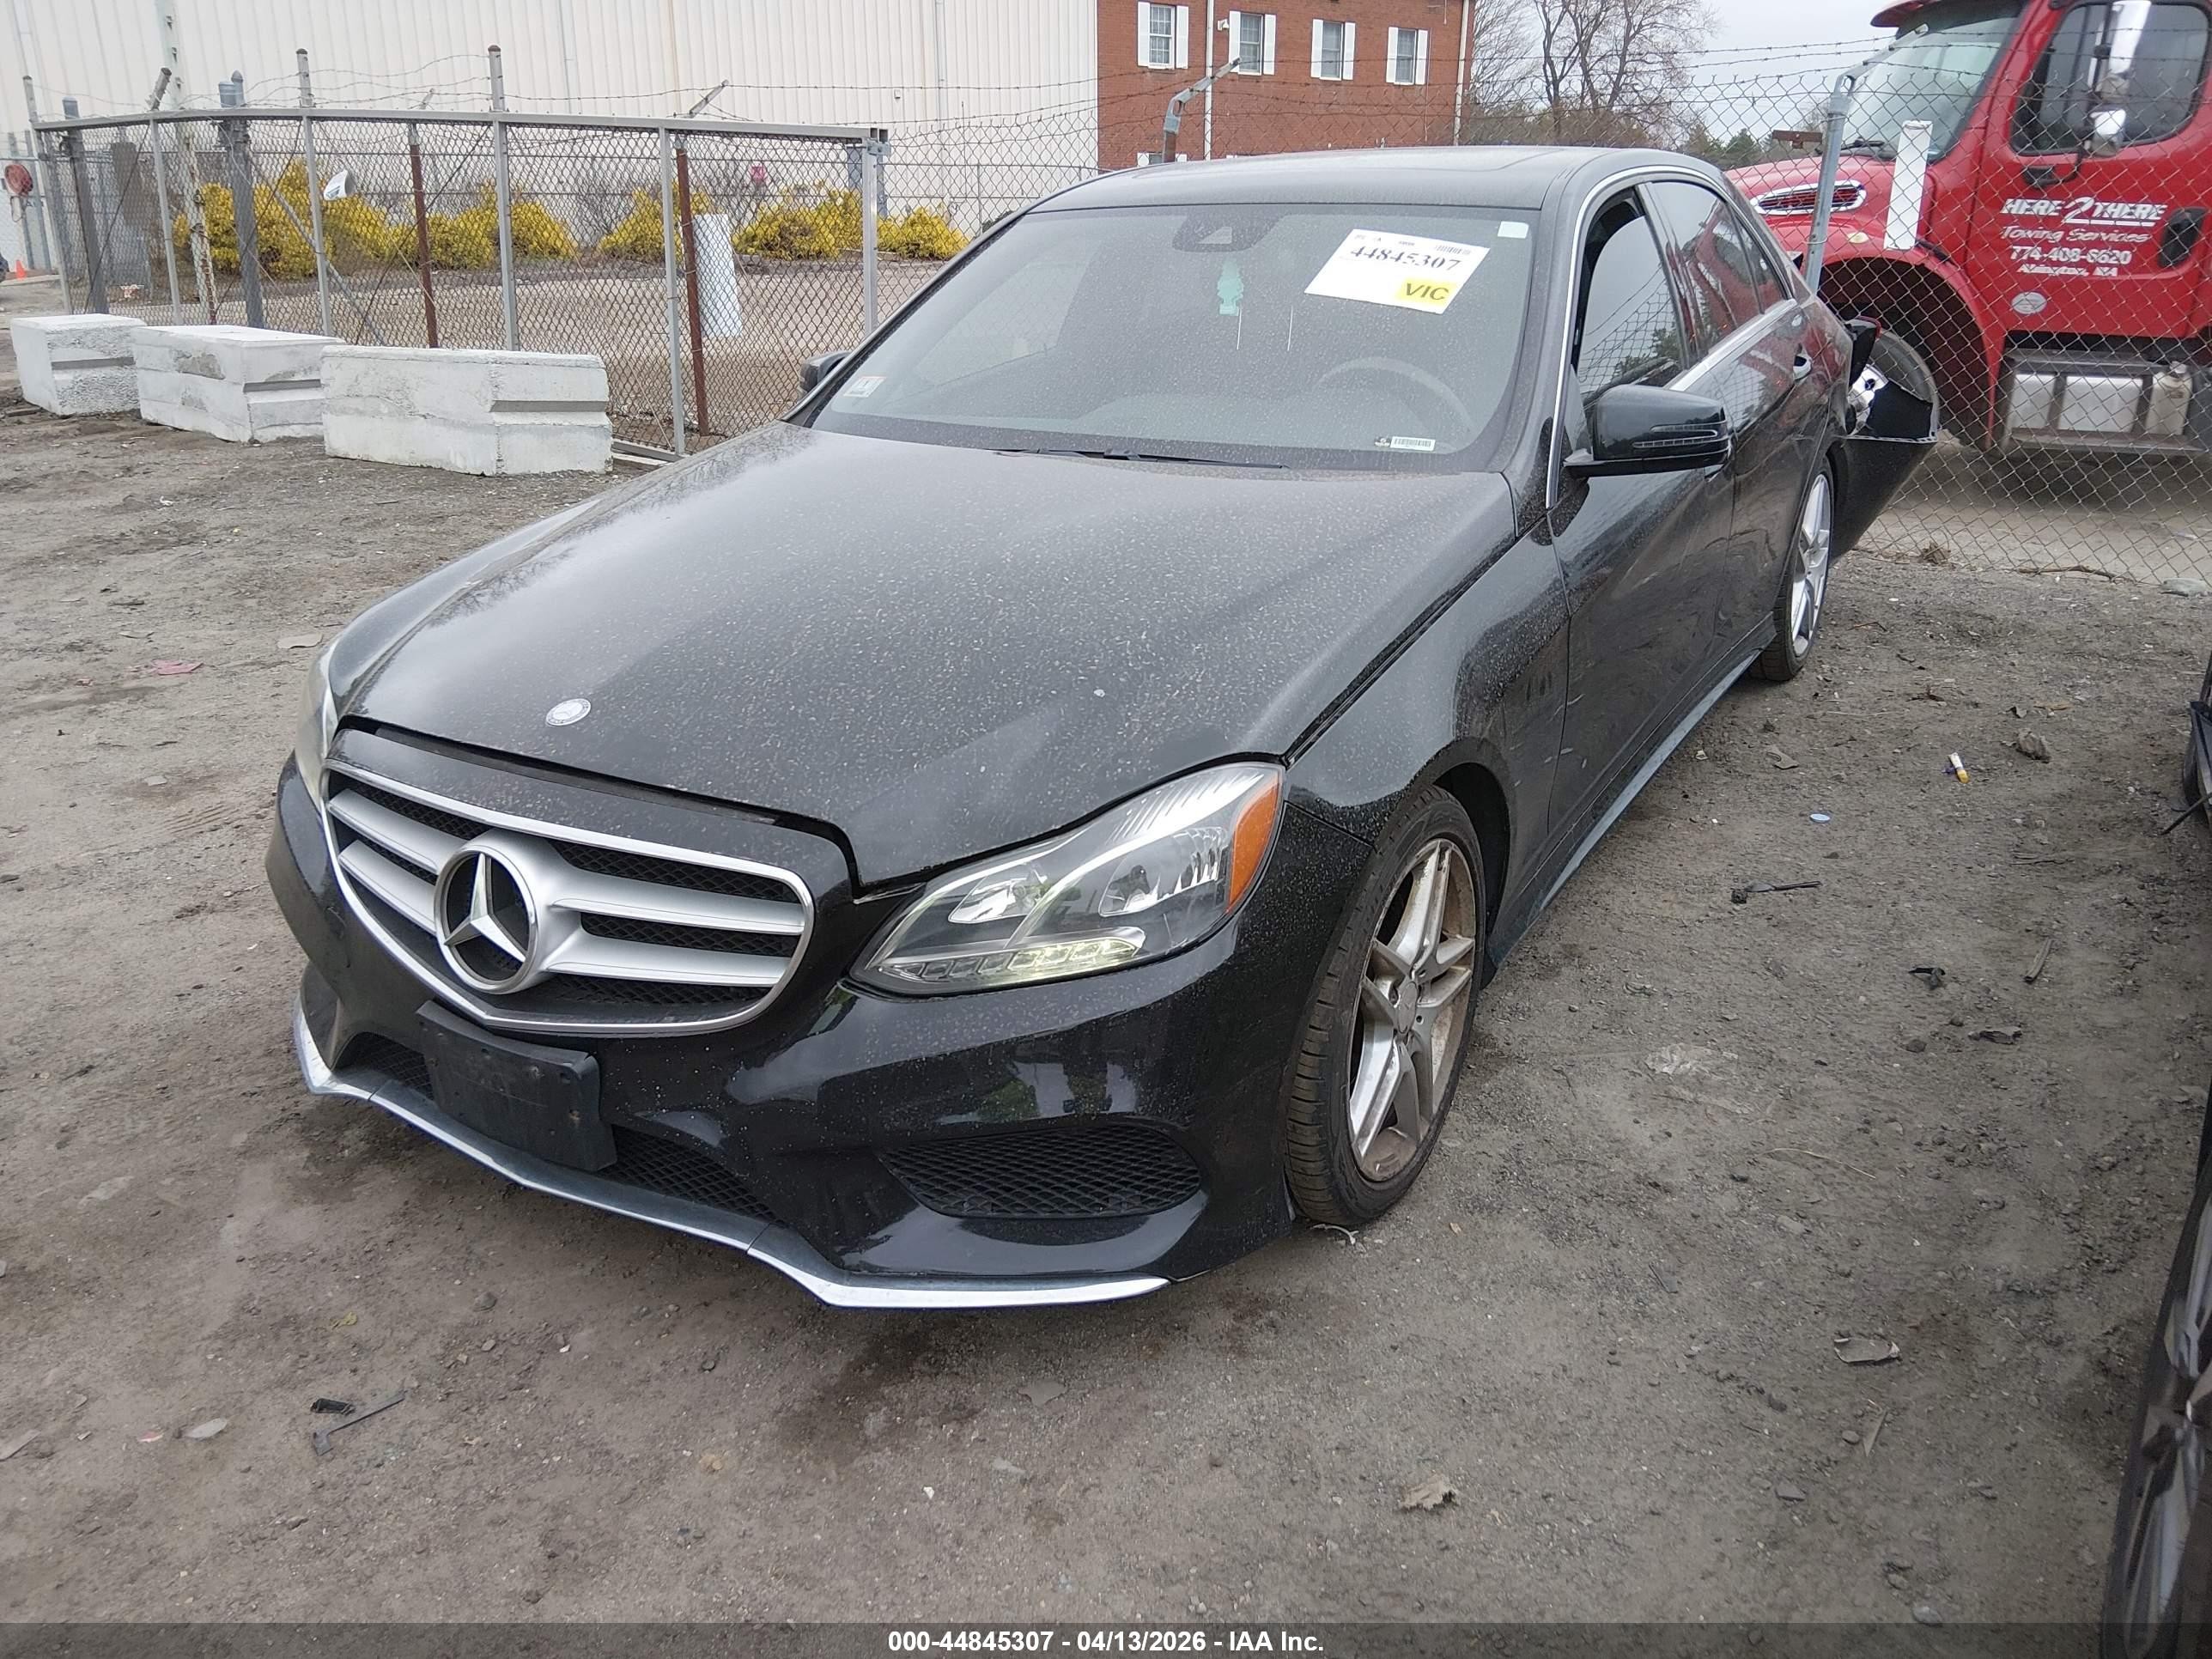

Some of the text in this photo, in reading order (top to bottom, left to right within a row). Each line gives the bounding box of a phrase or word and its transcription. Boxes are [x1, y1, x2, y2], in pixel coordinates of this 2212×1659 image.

[1999, 198, 2064, 216] HERE
[2092, 201, 2168, 220] THERE
[2001, 225, 2150, 243] Towing Services
[1350, 246, 1462, 271] 44845307
[1406, 283, 1449, 301] VIC
